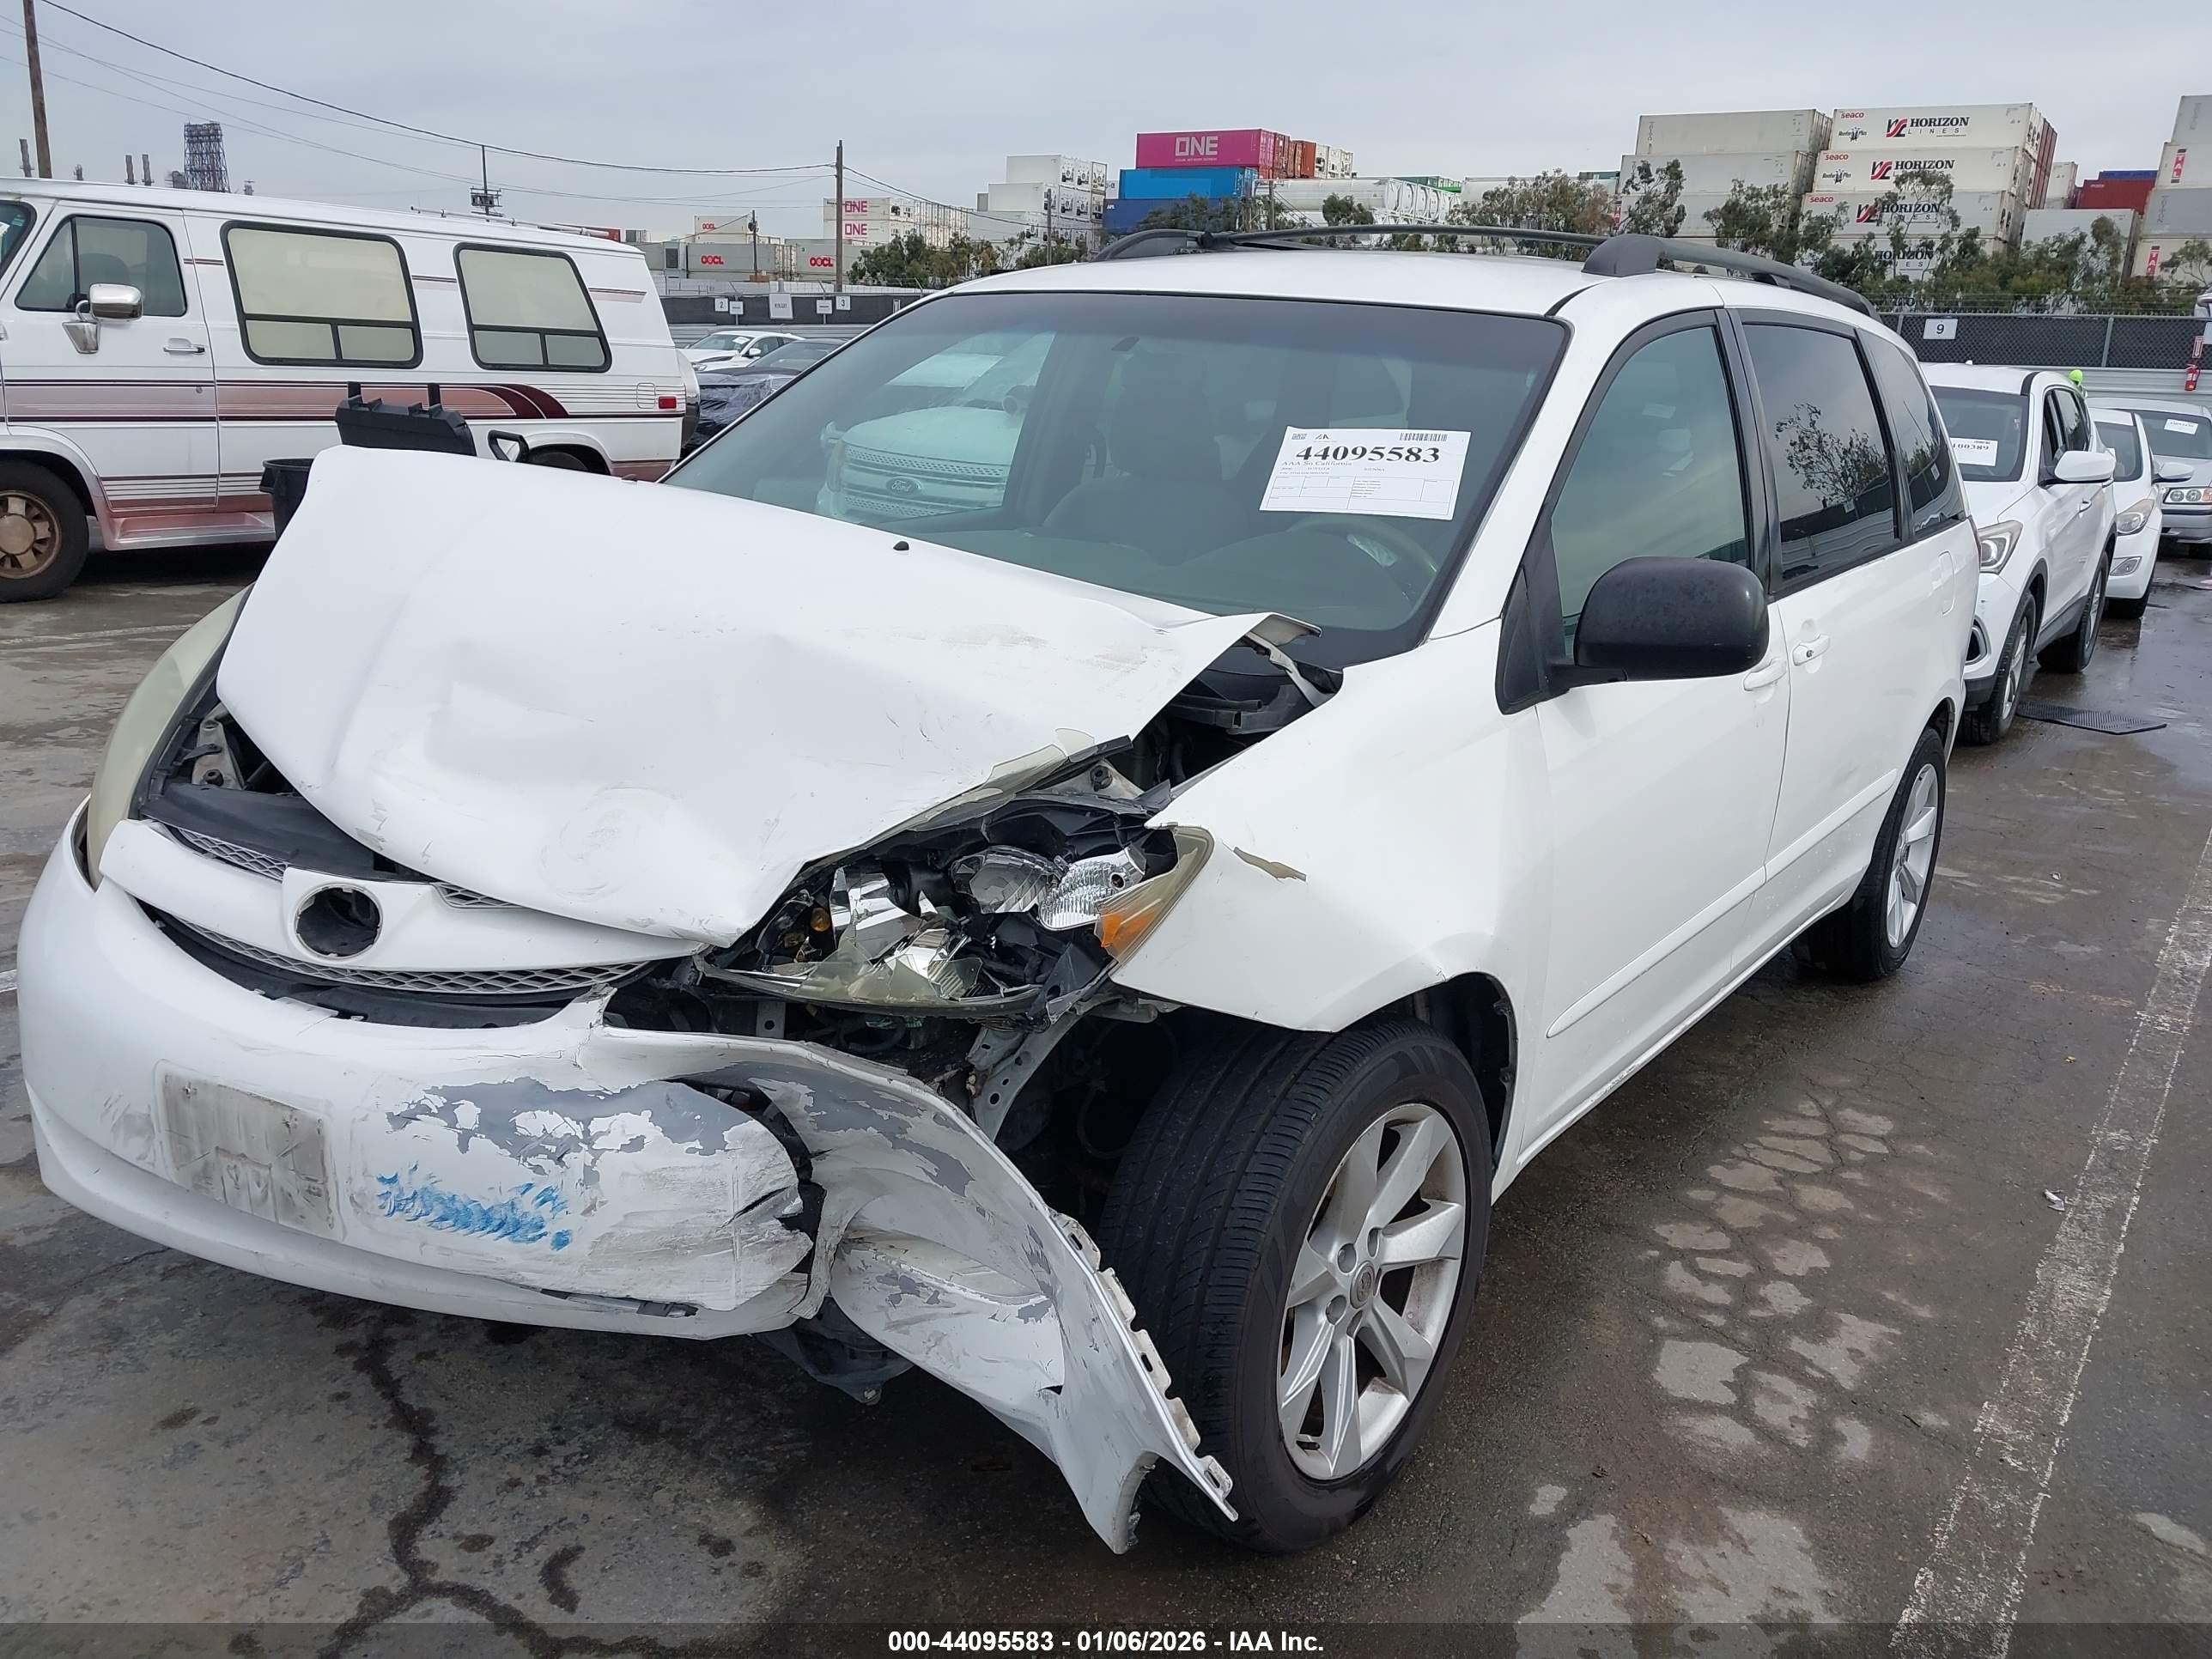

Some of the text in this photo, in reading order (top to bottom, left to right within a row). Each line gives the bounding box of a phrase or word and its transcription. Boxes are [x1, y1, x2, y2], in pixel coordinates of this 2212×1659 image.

[1910, 117, 1970, 128] HORIZON
[1175, 136, 1218, 157] ONE
[1894, 160, 1955, 170] HORIZON
[845, 200, 867, 213] ONE
[1881, 204, 1940, 213] HORIZON
[845, 223, 867, 235] ONE
[701, 256, 724, 264] OOCL
[810, 258, 834, 267] OOCL
[1936, 324, 1945, 334] 9
[1296, 446, 1440, 462] 44095583
[891, 480, 911, 492] Ford
